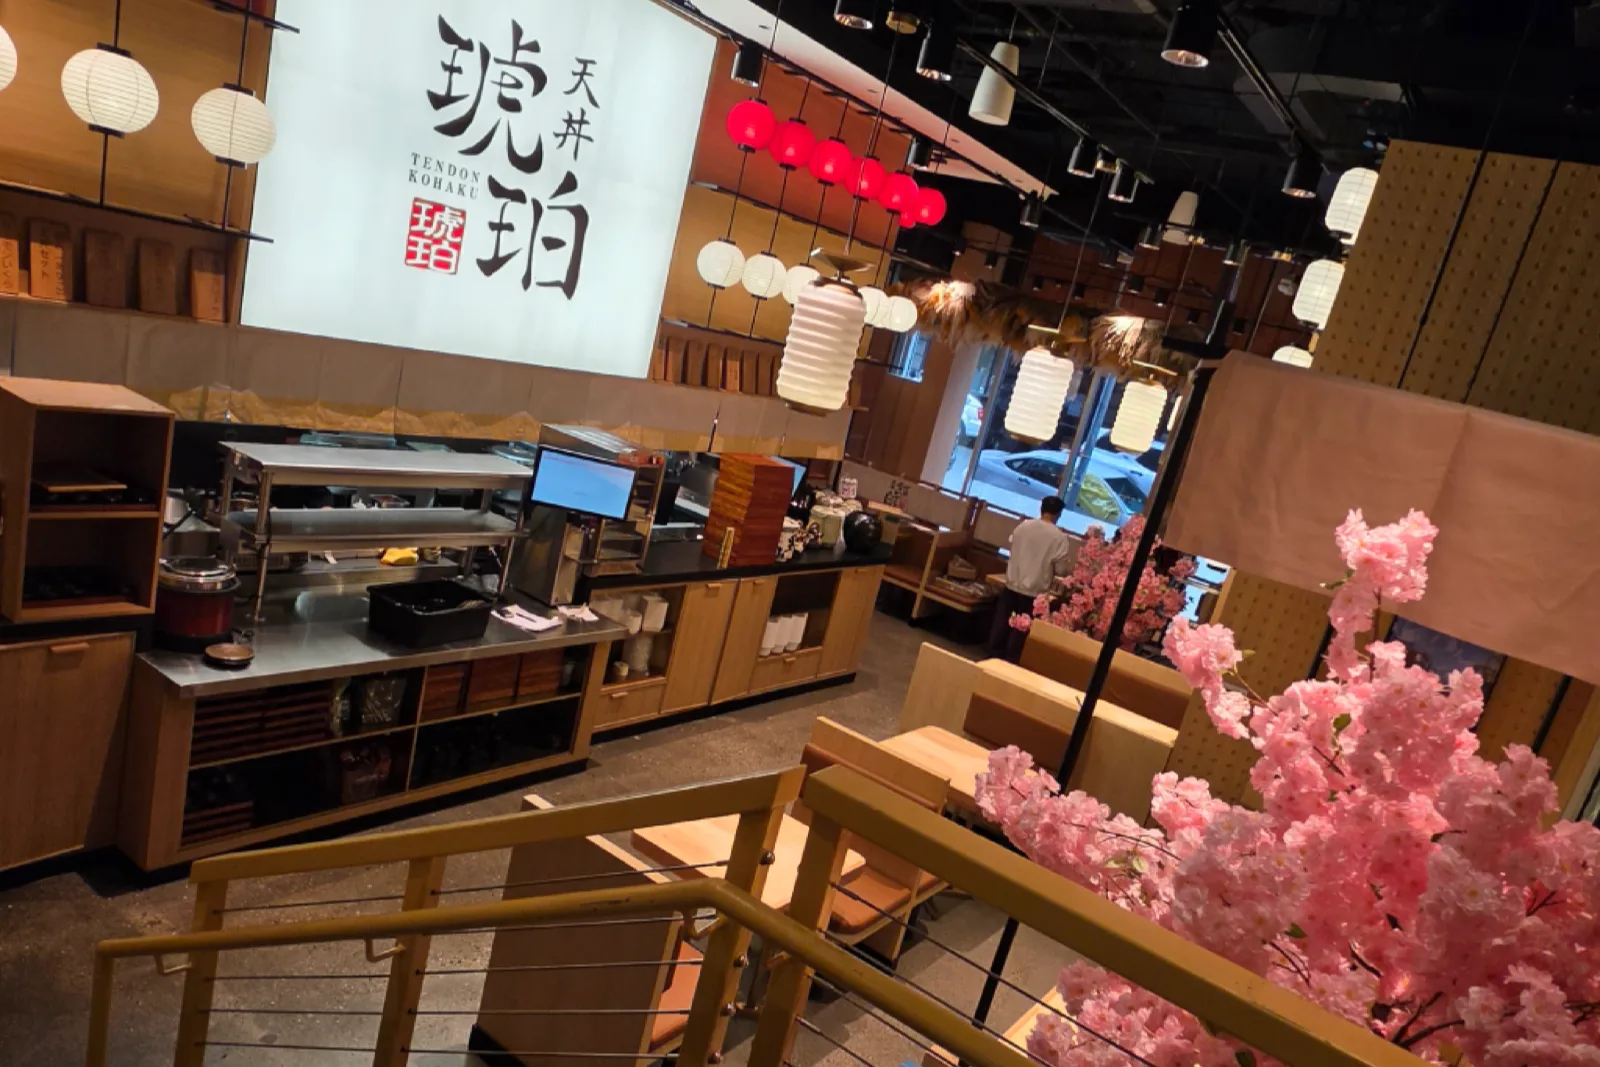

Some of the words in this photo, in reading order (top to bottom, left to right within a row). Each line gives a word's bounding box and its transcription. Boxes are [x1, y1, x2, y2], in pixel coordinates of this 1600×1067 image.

[552, 56, 600, 161] 天丼
[408, 168, 479, 200] KOHAKU
[411, 152, 481, 184] TENDON
[426, 13, 589, 300] 琥珀
